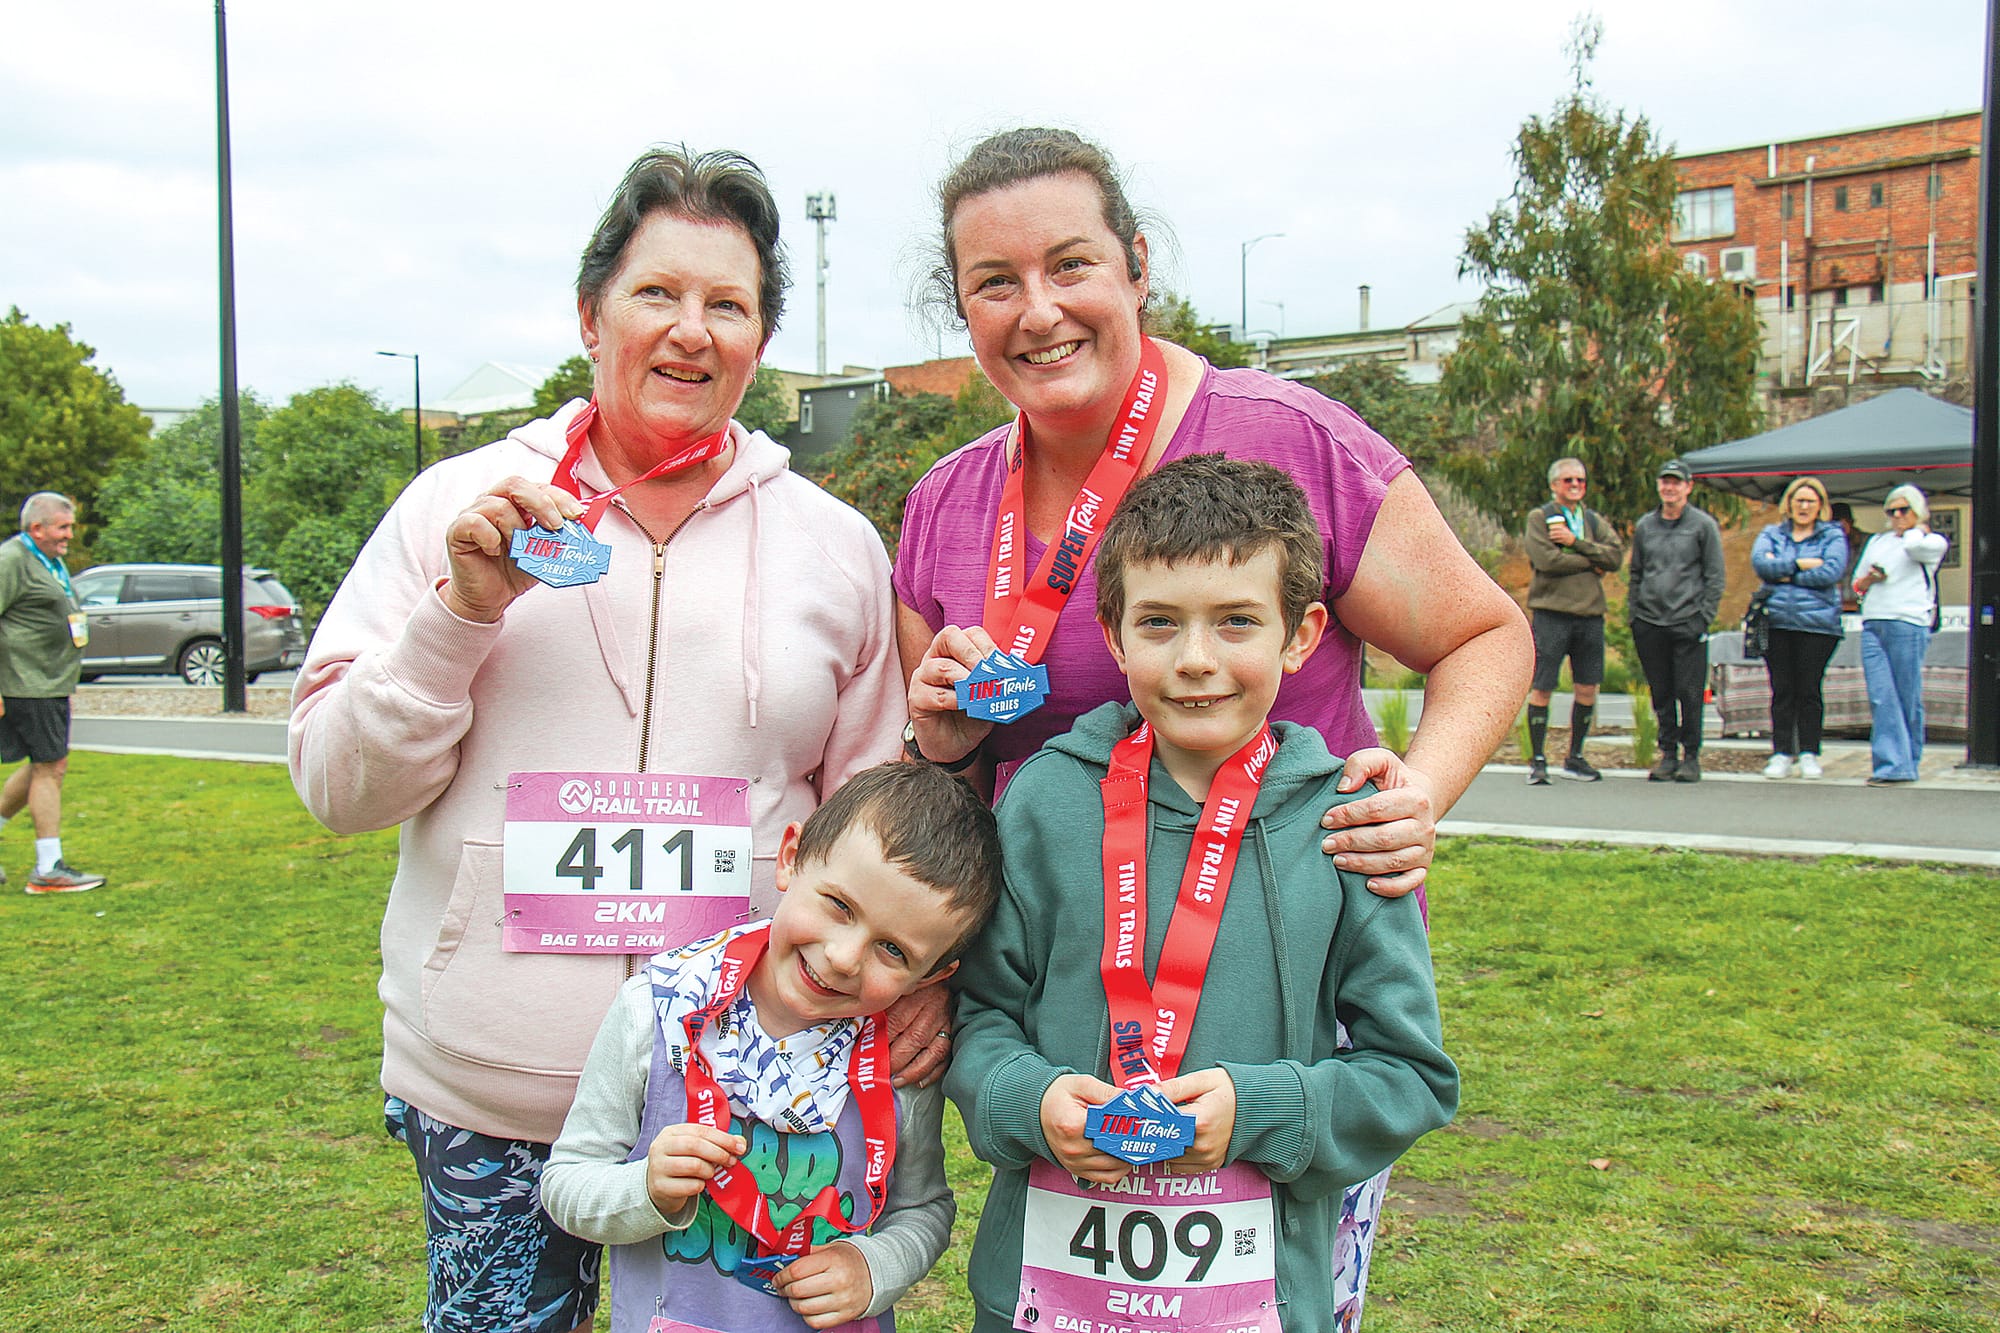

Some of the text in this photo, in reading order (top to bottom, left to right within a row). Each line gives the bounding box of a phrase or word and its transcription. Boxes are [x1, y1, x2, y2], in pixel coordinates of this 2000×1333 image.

[1113, 370, 1157, 461] TINY TRAILS
[524, 537, 566, 560] TINY
[995, 511, 1015, 599] TINY TRAILS
[541, 562, 575, 577] SERIES
[1047, 530, 1088, 596] SUPER
[1011, 624, 1036, 659] AILS
[968, 679, 1004, 702] TINY
[989, 698, 1020, 714] SERIES
[594, 780, 701, 799] SOUTHERN
[592, 797, 704, 817] RAIL TRAIL
[555, 827, 694, 891] 411
[1193, 796, 1241, 905] TINY TRAILS
[594, 902, 667, 924] 2KM
[1115, 860, 1137, 970] TINY TRAILS
[540, 933, 666, 948] BAG TAG 2KM
[1113, 1020, 1147, 1077] SUPER
[858, 1057, 876, 1092] TINY
[1100, 1113, 1142, 1137] TINY
[1120, 1140, 1157, 1155] SERIES
[1155, 1176, 1223, 1197] TRAIL
[1069, 1205, 1224, 1283] 409
[1106, 1289, 1183, 1319] 2KM
[1054, 1315, 1093, 1333] BAG
